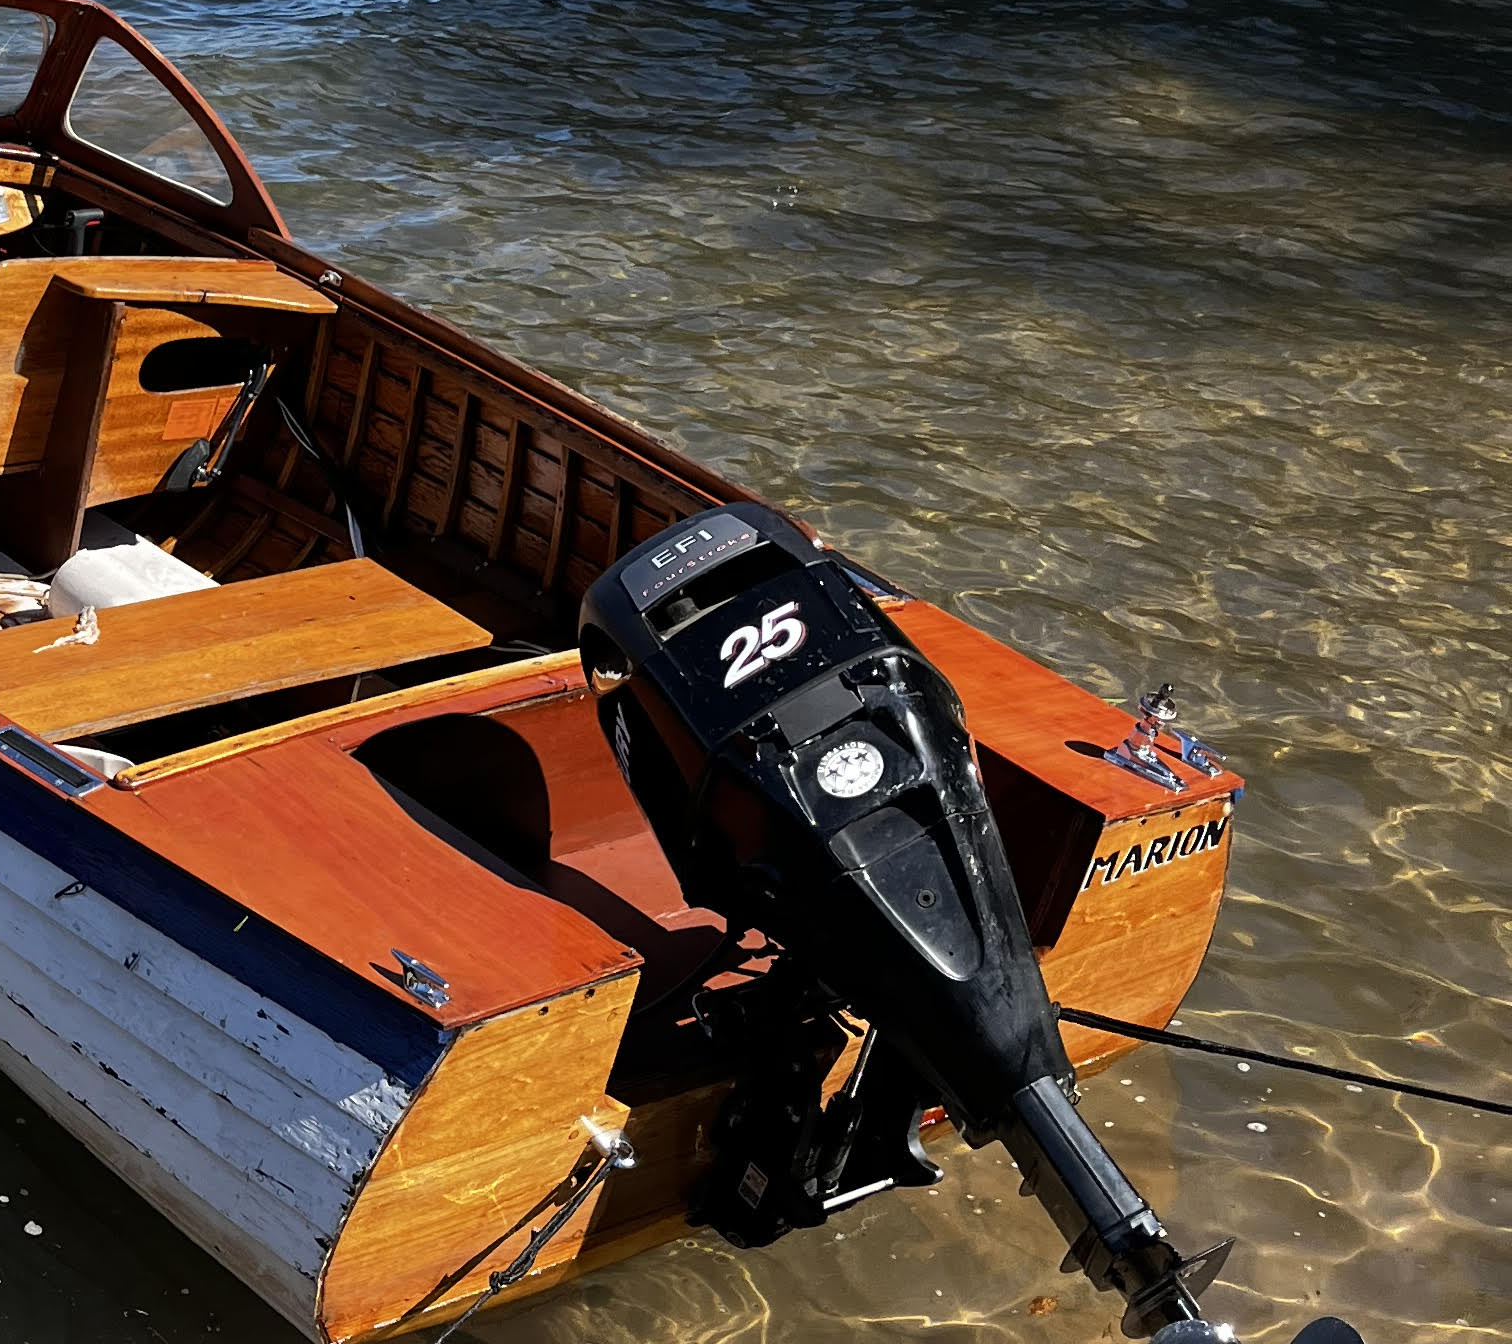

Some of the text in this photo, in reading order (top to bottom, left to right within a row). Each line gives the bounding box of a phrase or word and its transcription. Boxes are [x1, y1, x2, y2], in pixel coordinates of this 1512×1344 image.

[651, 529, 713, 569] EFI
[720, 601, 806, 689] 25
[1080, 817, 1228, 892] MARION
